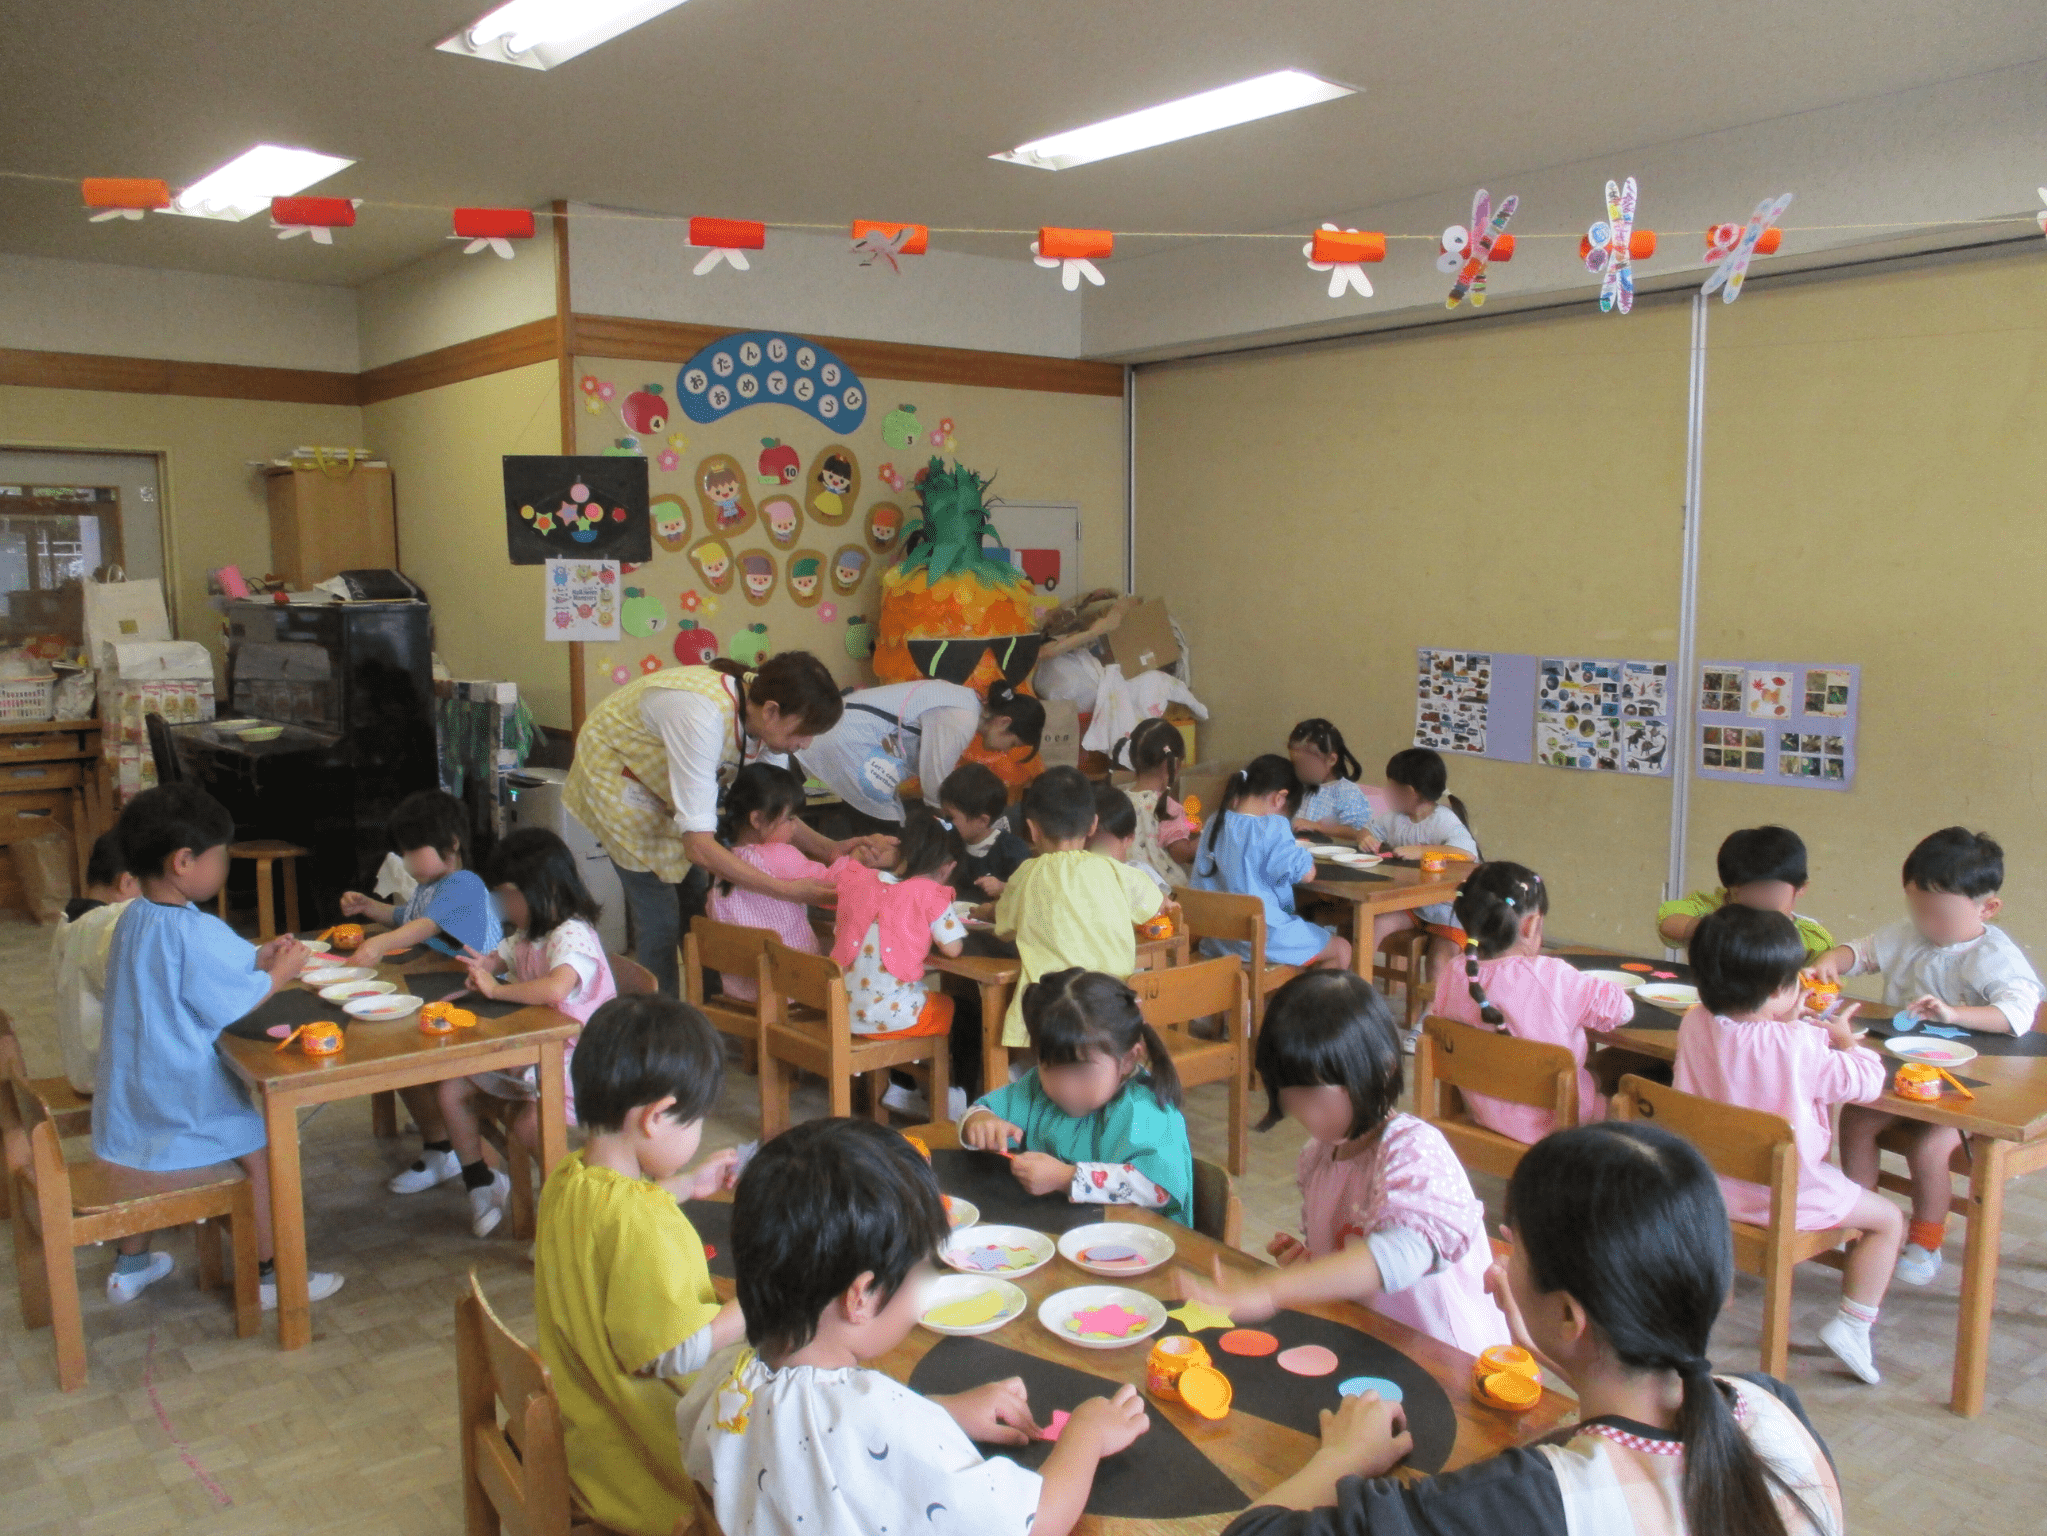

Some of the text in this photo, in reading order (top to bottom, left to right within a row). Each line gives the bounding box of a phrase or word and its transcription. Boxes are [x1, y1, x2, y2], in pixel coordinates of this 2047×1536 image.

[713, 376, 835, 413] おめでとう
[653, 419, 661, 429] 4
[907, 435, 913, 445] 3
[785, 467, 797, 477] 10
[651, 619, 658, 630] 7
[704, 651, 711, 661] 8
[757, 652, 765, 662] 9
